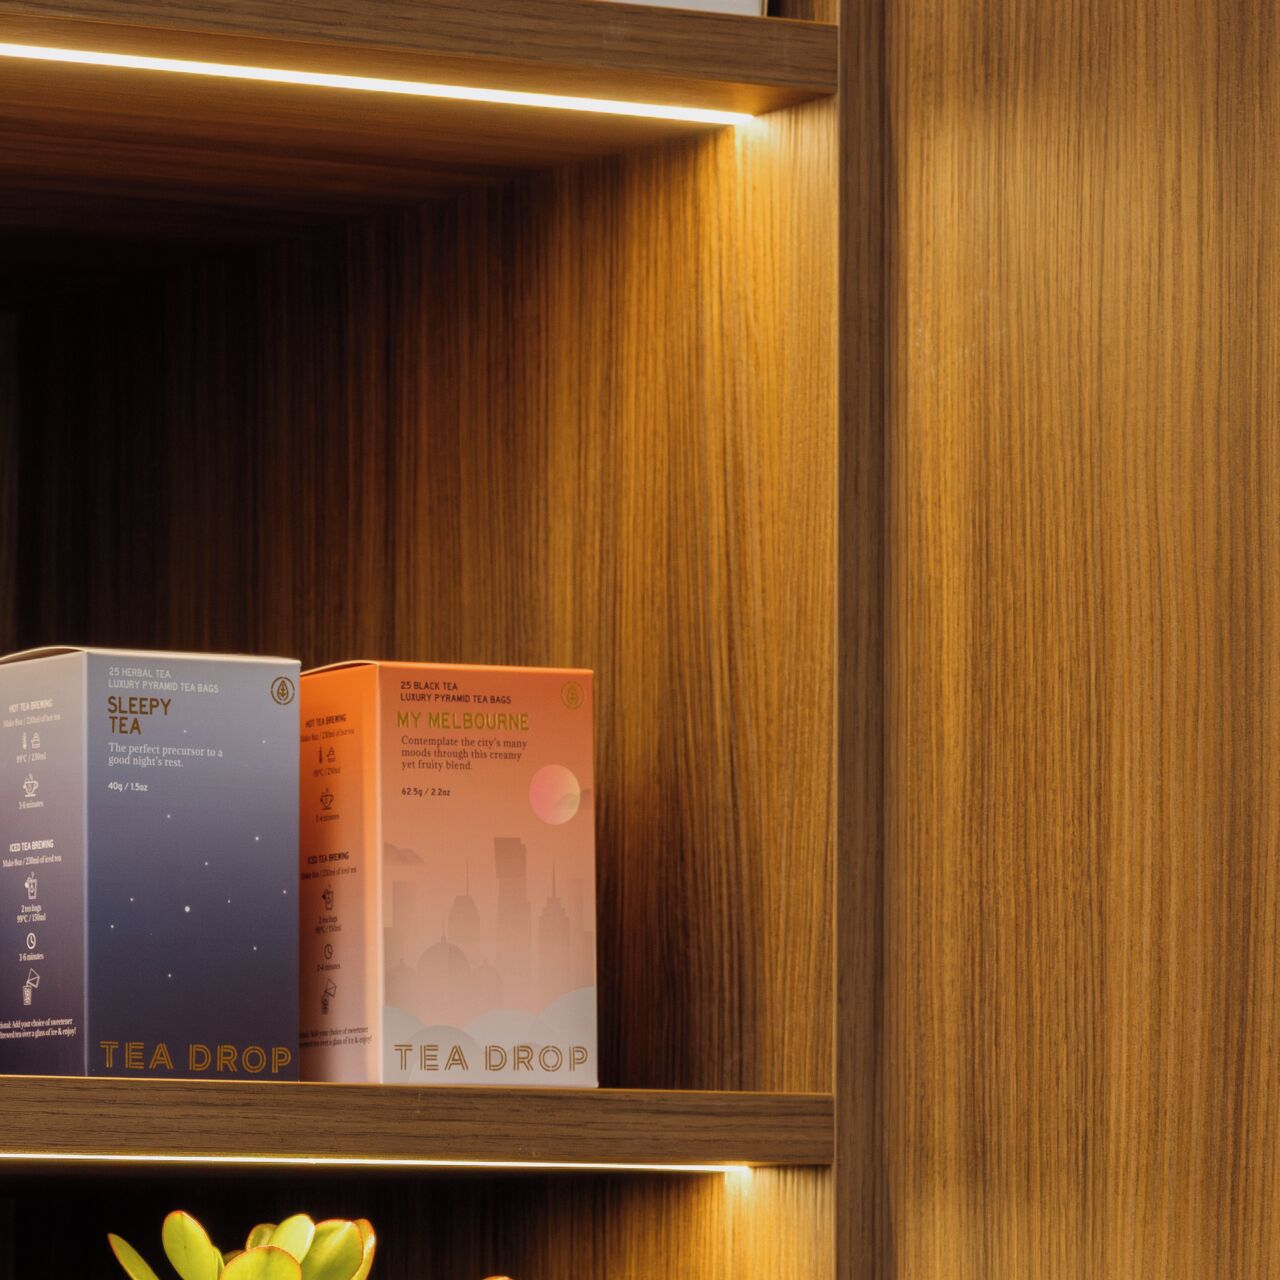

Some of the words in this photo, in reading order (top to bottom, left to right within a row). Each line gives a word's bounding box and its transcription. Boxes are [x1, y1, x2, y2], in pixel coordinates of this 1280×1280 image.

[108, 667, 120, 677] 25
[121, 667, 153, 678] HERBAL
[155, 669, 172, 679] TEA
[108, 680, 140, 690] LUXURY
[142, 681, 178, 692] PYRAMID
[180, 682, 195, 692] TEA
[197, 683, 219, 693] BAGS
[400, 681, 412, 690] 25
[413, 681, 440, 691] BLACK
[442, 682, 458, 691] TEA
[107, 695, 172, 716] SLEEPY
[400, 693, 432, 702] LUXURY
[434, 694, 470, 703] PYRAMID
[473, 694, 488, 704] TEA
[490, 695, 512, 705] BAGS
[108, 716, 142, 735] TEA
[397, 711, 422, 729] MY
[428, 711, 530, 731] MELBOURNE
[401, 735, 459, 750] Contemplate
[461, 736, 475, 748] the
[477, 737, 502, 751] city's
[503, 739, 528, 751] many
[108, 742, 127, 754] The
[128, 743, 160, 757] perfect
[162, 746, 205, 759] precursor
[206, 748, 216, 757] to
[217, 750, 223, 758] a
[401, 748, 432, 758] moods
[433, 749, 469, 761] through
[471, 749, 487, 760] this
[489, 751, 522, 762] creamy
[108, 755, 131, 767] good
[132, 756, 163, 768] night's
[164, 758, 184, 768] rest.
[401, 760, 415, 771] yet
[417, 760, 443, 772] fruity
[445, 760, 472, 771] blend.
[108, 782, 123, 793] 40g
[131, 782, 148, 792] 1.5oz
[401, 787, 423, 798] 62.5g
[431, 787, 451, 797] 2.2oz
[99, 1040, 174, 1070] TEA
[189, 1043, 291, 1073] DROP
[394, 1044, 469, 1072] TEA
[484, 1045, 589, 1073] DROP
